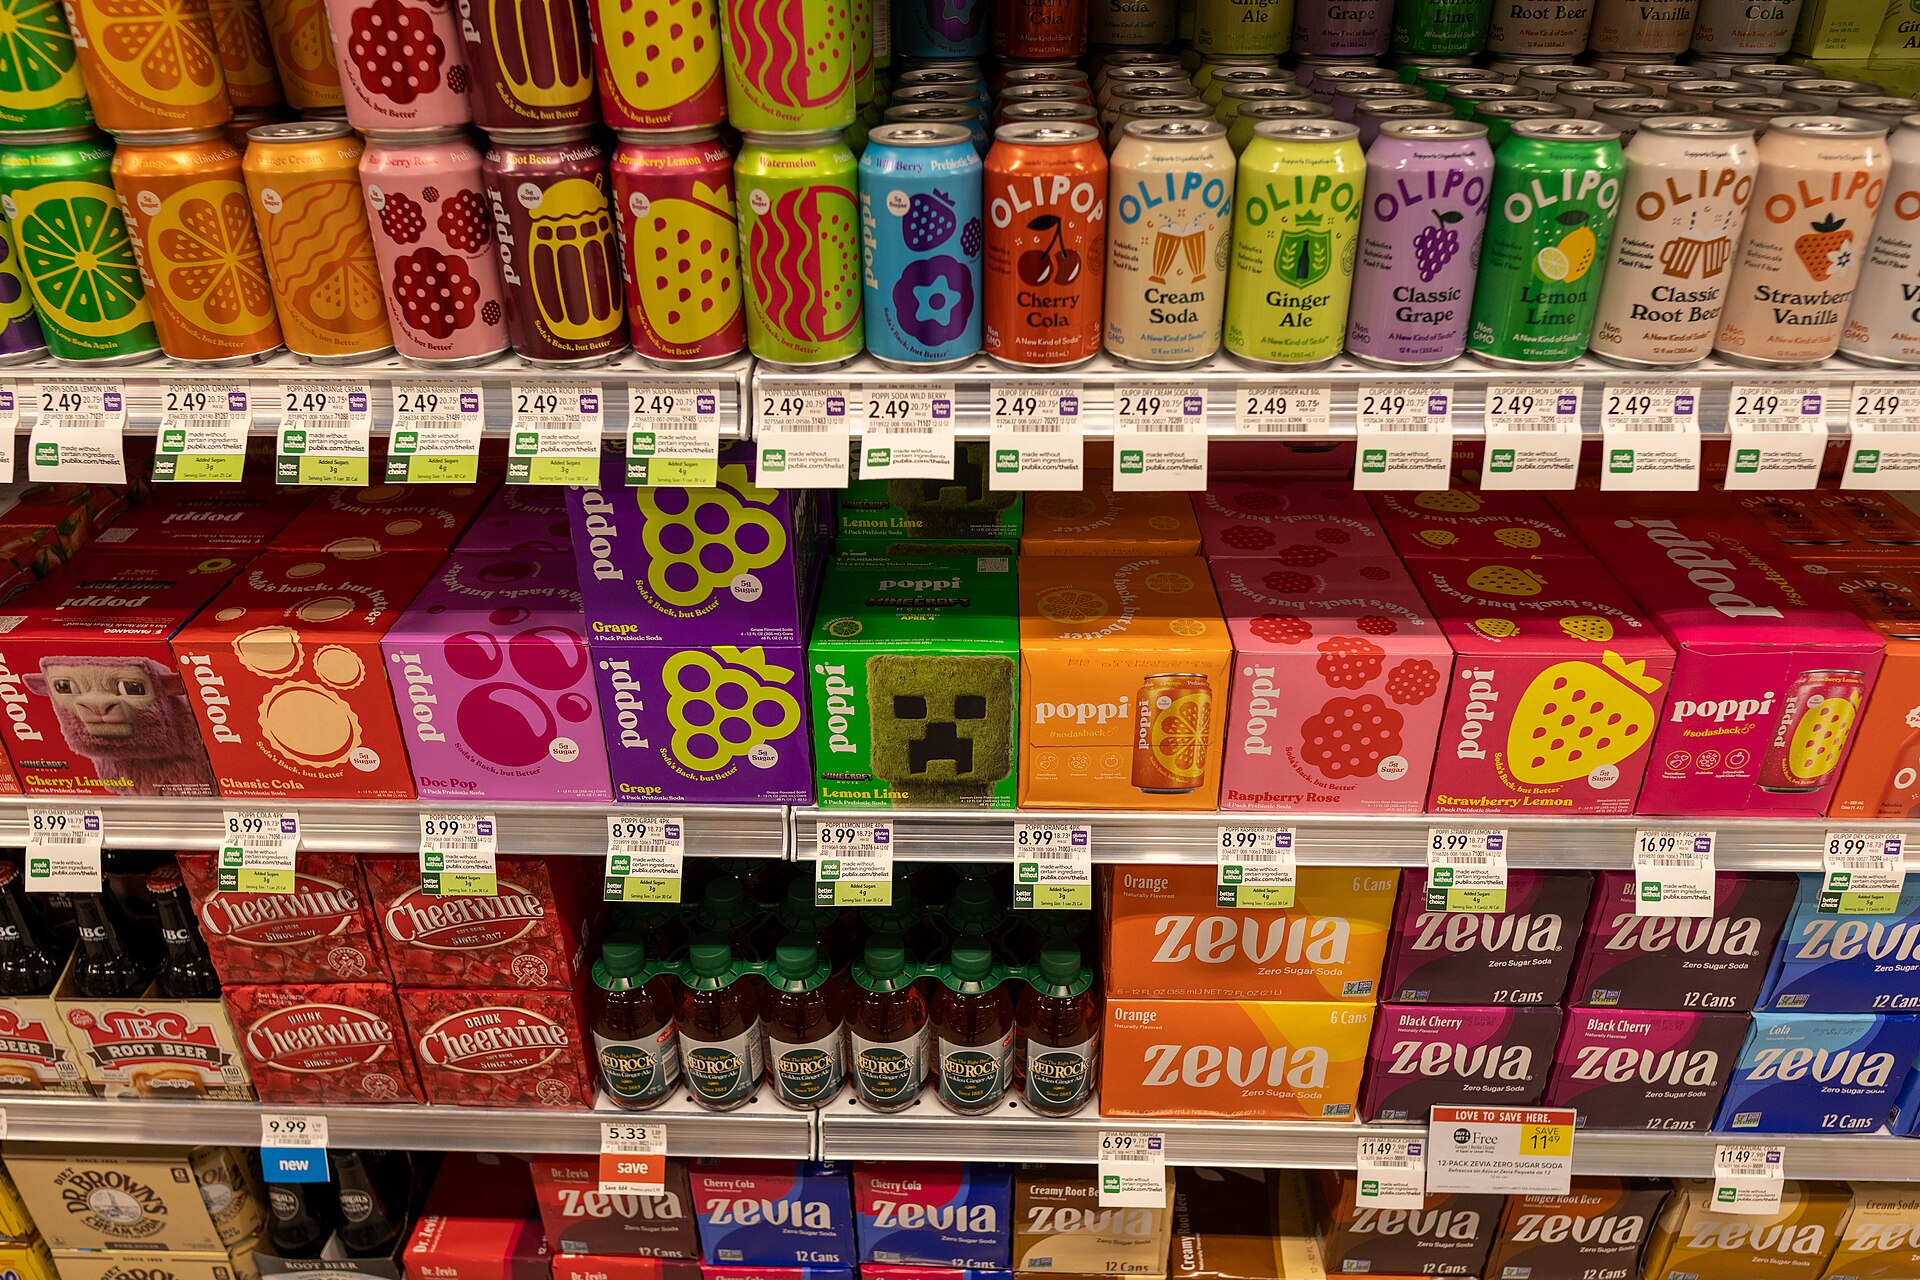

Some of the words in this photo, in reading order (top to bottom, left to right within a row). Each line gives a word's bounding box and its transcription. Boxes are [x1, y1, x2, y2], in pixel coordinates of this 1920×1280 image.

[1030, 11, 1064, 27] Cola
[1242, 9, 1268, 23] Ale
[1328, 7, 1375, 22] Grape
[1434, 10, 1473, 25] Lime
[1510, 5, 1554, 20] Root
[1557, 5, 1587, 19] Beer
[1640, 7, 1690, 22] Vanilla
[1745, 6, 1784, 20] Cola
[529, 155, 552, 164] Beer
[667, 156, 701, 166] Lemon
[759, 157, 816, 170] Watermelon
[991, 175, 1104, 228] OLIPOP
[1119, 172, 1233, 224] OLIPOP
[862, 191, 879, 289] poppi
[1017, 292, 1080, 309] Cherry
[1144, 288, 1205, 304] Cream
[1266, 292, 1331, 309] Ginger
[1393, 287, 1461, 304] Classic
[1521, 287, 1588, 304] Lemon
[1652, 286, 1720, 302] Classic
[1026, 313, 1069, 328] Cola
[1149, 308, 1199, 324] Soda
[1279, 312, 1313, 327] Ale
[1396, 306, 1453, 326] Grape
[1526, 308, 1576, 325] Lime
[1630, 304, 1682, 322] Root
[1690, 306, 1720, 321] Beer
[1773, 308, 1838, 326] Vanilla
[552, 339, 575, 351] Back,
[43, 393, 82, 412] 2.49
[167, 393, 206, 411] 2.49
[286, 393, 326, 412] 2.49
[399, 394, 437, 412] 2.49
[517, 395, 557, 413] 2.49
[634, 396, 674, 414] 2.49
[764, 398, 804, 416] 2.49
[996, 398, 1036, 416] 2.49
[62, 458, 121, 466] publix.com/thelist
[843, 517, 887, 528] Lemon
[890, 517, 923, 529] Lime
[734, 585, 759, 594] Sugar
[879, 577, 963, 591] poppi
[592, 621, 638, 635] Grape
[180, 653, 242, 744] poppi
[391, 651, 446, 744] poppi
[599, 659, 649, 749] poppi
[815, 662, 857, 754] poppi
[1243, 665, 1280, 756] poppi
[1050, 728, 1105, 738] #sodasback
[1683, 725, 1741, 738] #sodasback
[25, 774, 73, 791] Cherry
[76, 776, 134, 788] Limeade
[220, 778, 268, 790] Classic
[271, 778, 304, 791] Cola
[420, 776, 449, 788] Doc
[452, 777, 477, 791] Pop
[822, 788, 870, 800] Lemon
[873, 788, 909, 800] Lime
[1227, 790, 1303, 805] Raspberry
[1306, 792, 1340, 804] Rose
[1438, 794, 1520, 808] Strawberry
[1523, 795, 1573, 808] Lemon
[33, 816, 66, 830] 8.99
[229, 818, 262, 832] 8.99
[425, 821, 458, 836] 8.99
[612, 824, 646, 838] 8.99
[822, 829, 855, 843] 8.99
[1018, 831, 1052, 846] 8.99
[1640, 838, 1675, 851] 16.99
[1124, 874, 1168, 891] Orange
[1353, 877, 1360, 890] 6
[1363, 877, 1392, 891] Cans
[202, 884, 358, 936] Cheerwine
[385, 894, 545, 943] Cheerwine
[1257, 967, 1281, 976] Zero
[1283, 967, 1313, 977] Sugar
[1315, 967, 1343, 976] Soda
[1684, 992, 1697, 1006] 12
[1701, 993, 1736, 1007] Cans
[286, 1011, 322, 1025] DRINK
[464, 1014, 501, 1028] DRINK
[1115, 1008, 1157, 1023] Orange
[1331, 1011, 1338, 1024] 6
[1340, 1010, 1367, 1024] Cans
[1399, 1015, 1421, 1027] Black
[1424, 1015, 1462, 1030] Cherry
[114, 1018, 182, 1040] IBC
[1587, 1019, 1615, 1032] Black
[1617, 1021, 1651, 1036] Cherry
[1769, 1025, 1791, 1036] Cola
[246, 1016, 393, 1062] Cheerwine
[106, 1044, 155, 1058] ROOT
[161, 1044, 207, 1059] BEER
[223, 1068, 239, 1076] 160
[965, 1059, 1002, 1078] ROCK
[1456, 1111, 1478, 1120] LOVE
[1484, 1112, 1494, 1120] TO
[1500, 1113, 1521, 1122] SAVE
[1526, 1114, 1551, 1123] HERE.
[1822, 1114, 1836, 1128] 12
[1839, 1114, 1873, 1129] Cans
[270, 1121, 306, 1133] 9.99
[609, 1128, 646, 1139] 5.33
[1102, 1137, 1132, 1149] 6.99
[1473, 1132, 1498, 1144] Free
[1361, 1143, 1391, 1155] 11.49
[1720, 1151, 1749, 1162] 11.49
[279, 1158, 309, 1172] new
[617, 1162, 648, 1174] save
[54, 1167, 74, 1186] DIET
[551, 1168, 563, 1178] Dr.
[565, 1168, 589, 1179] Zevia
[703, 1178, 733, 1190] Cherry
[736, 1179, 755, 1189] Cola
[871, 1179, 899, 1192] Cherry
[902, 1181, 921, 1191] Cola
[1030, 1186, 1062, 1198] Creamy
[1065, 1186, 1086, 1196] Root
[1865, 1200, 1895, 1210] Cream
[1896, 1201, 1919, 1210] Soda
[796, 1251, 809, 1261] 12
[810, 1251, 839, 1263] Cans
